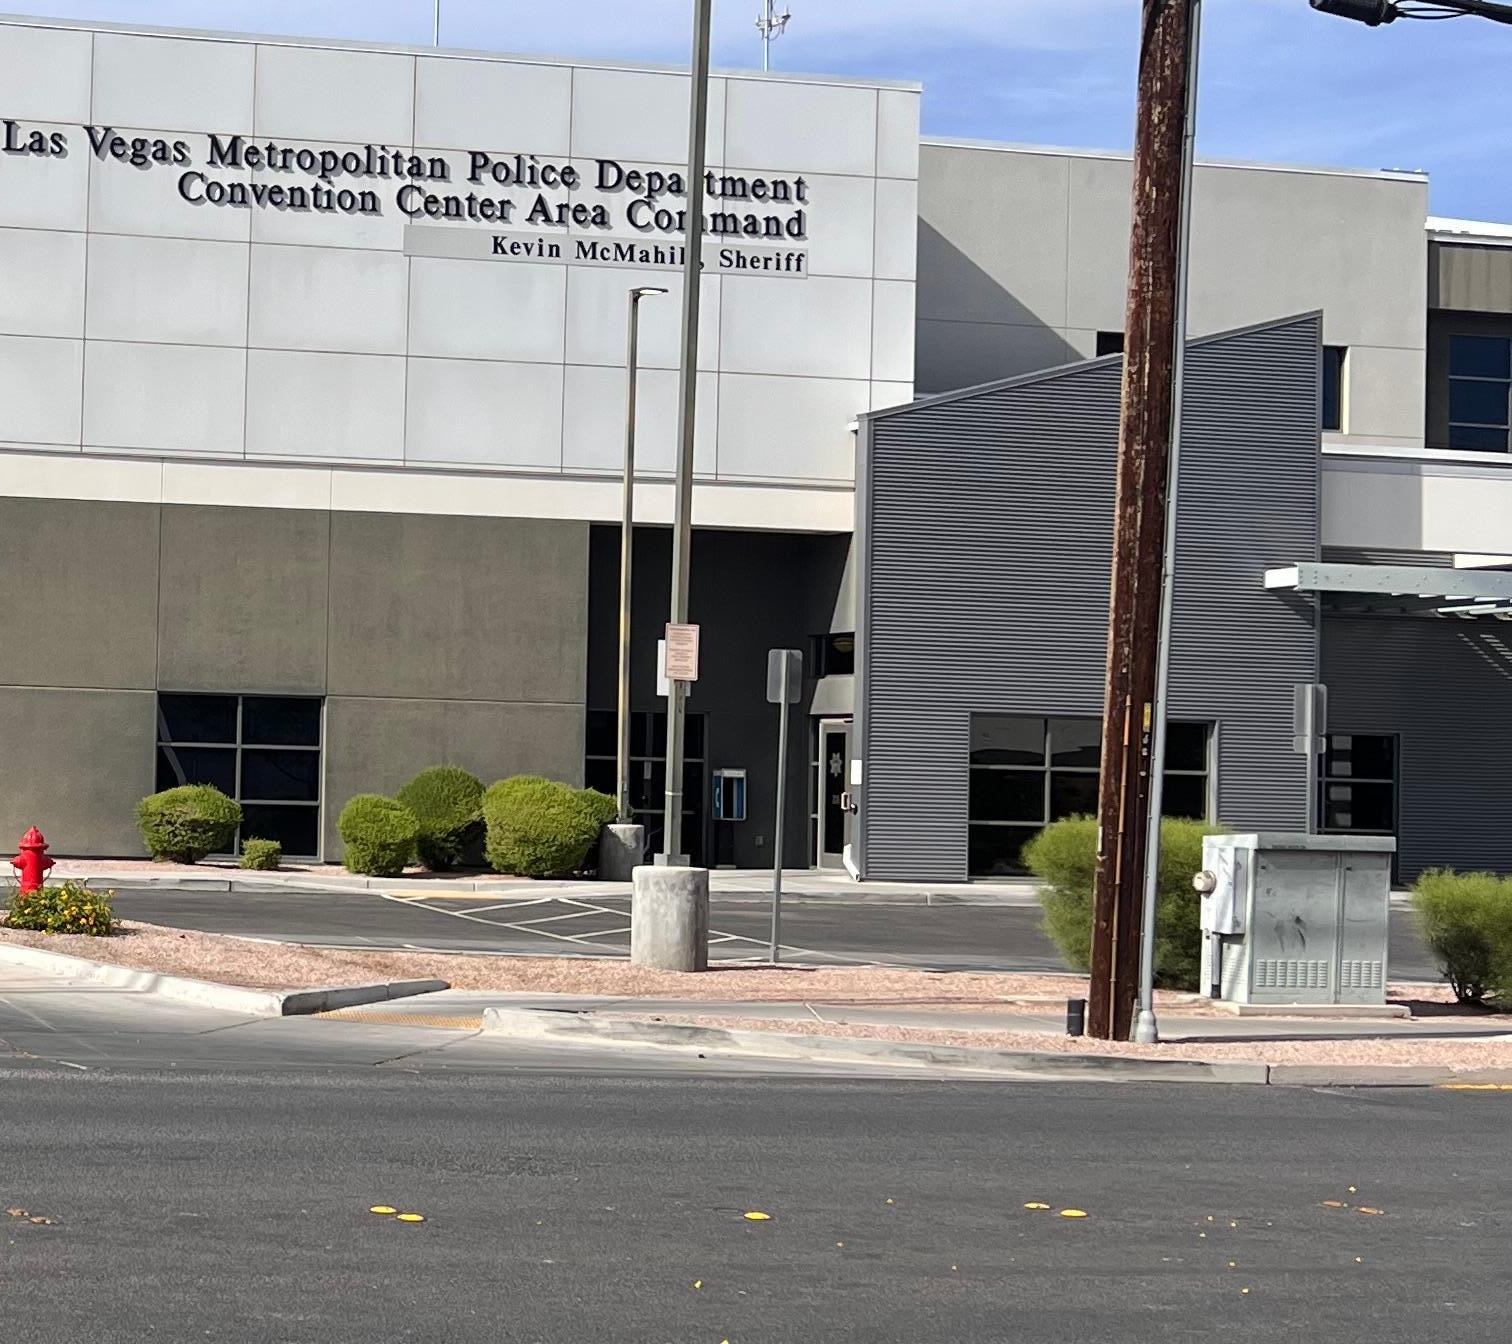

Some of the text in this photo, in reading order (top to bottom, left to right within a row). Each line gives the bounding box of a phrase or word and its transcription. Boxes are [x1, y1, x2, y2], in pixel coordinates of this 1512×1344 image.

[2, 121, 809, 201] Las Vegas Metropolitan Police Depatment
[178, 171, 381, 213] Convention
[396, 184, 513, 220] Center
[525, 193, 609, 227] Area
[492, 235, 807, 274] Kevin McMahil, Sheriff
